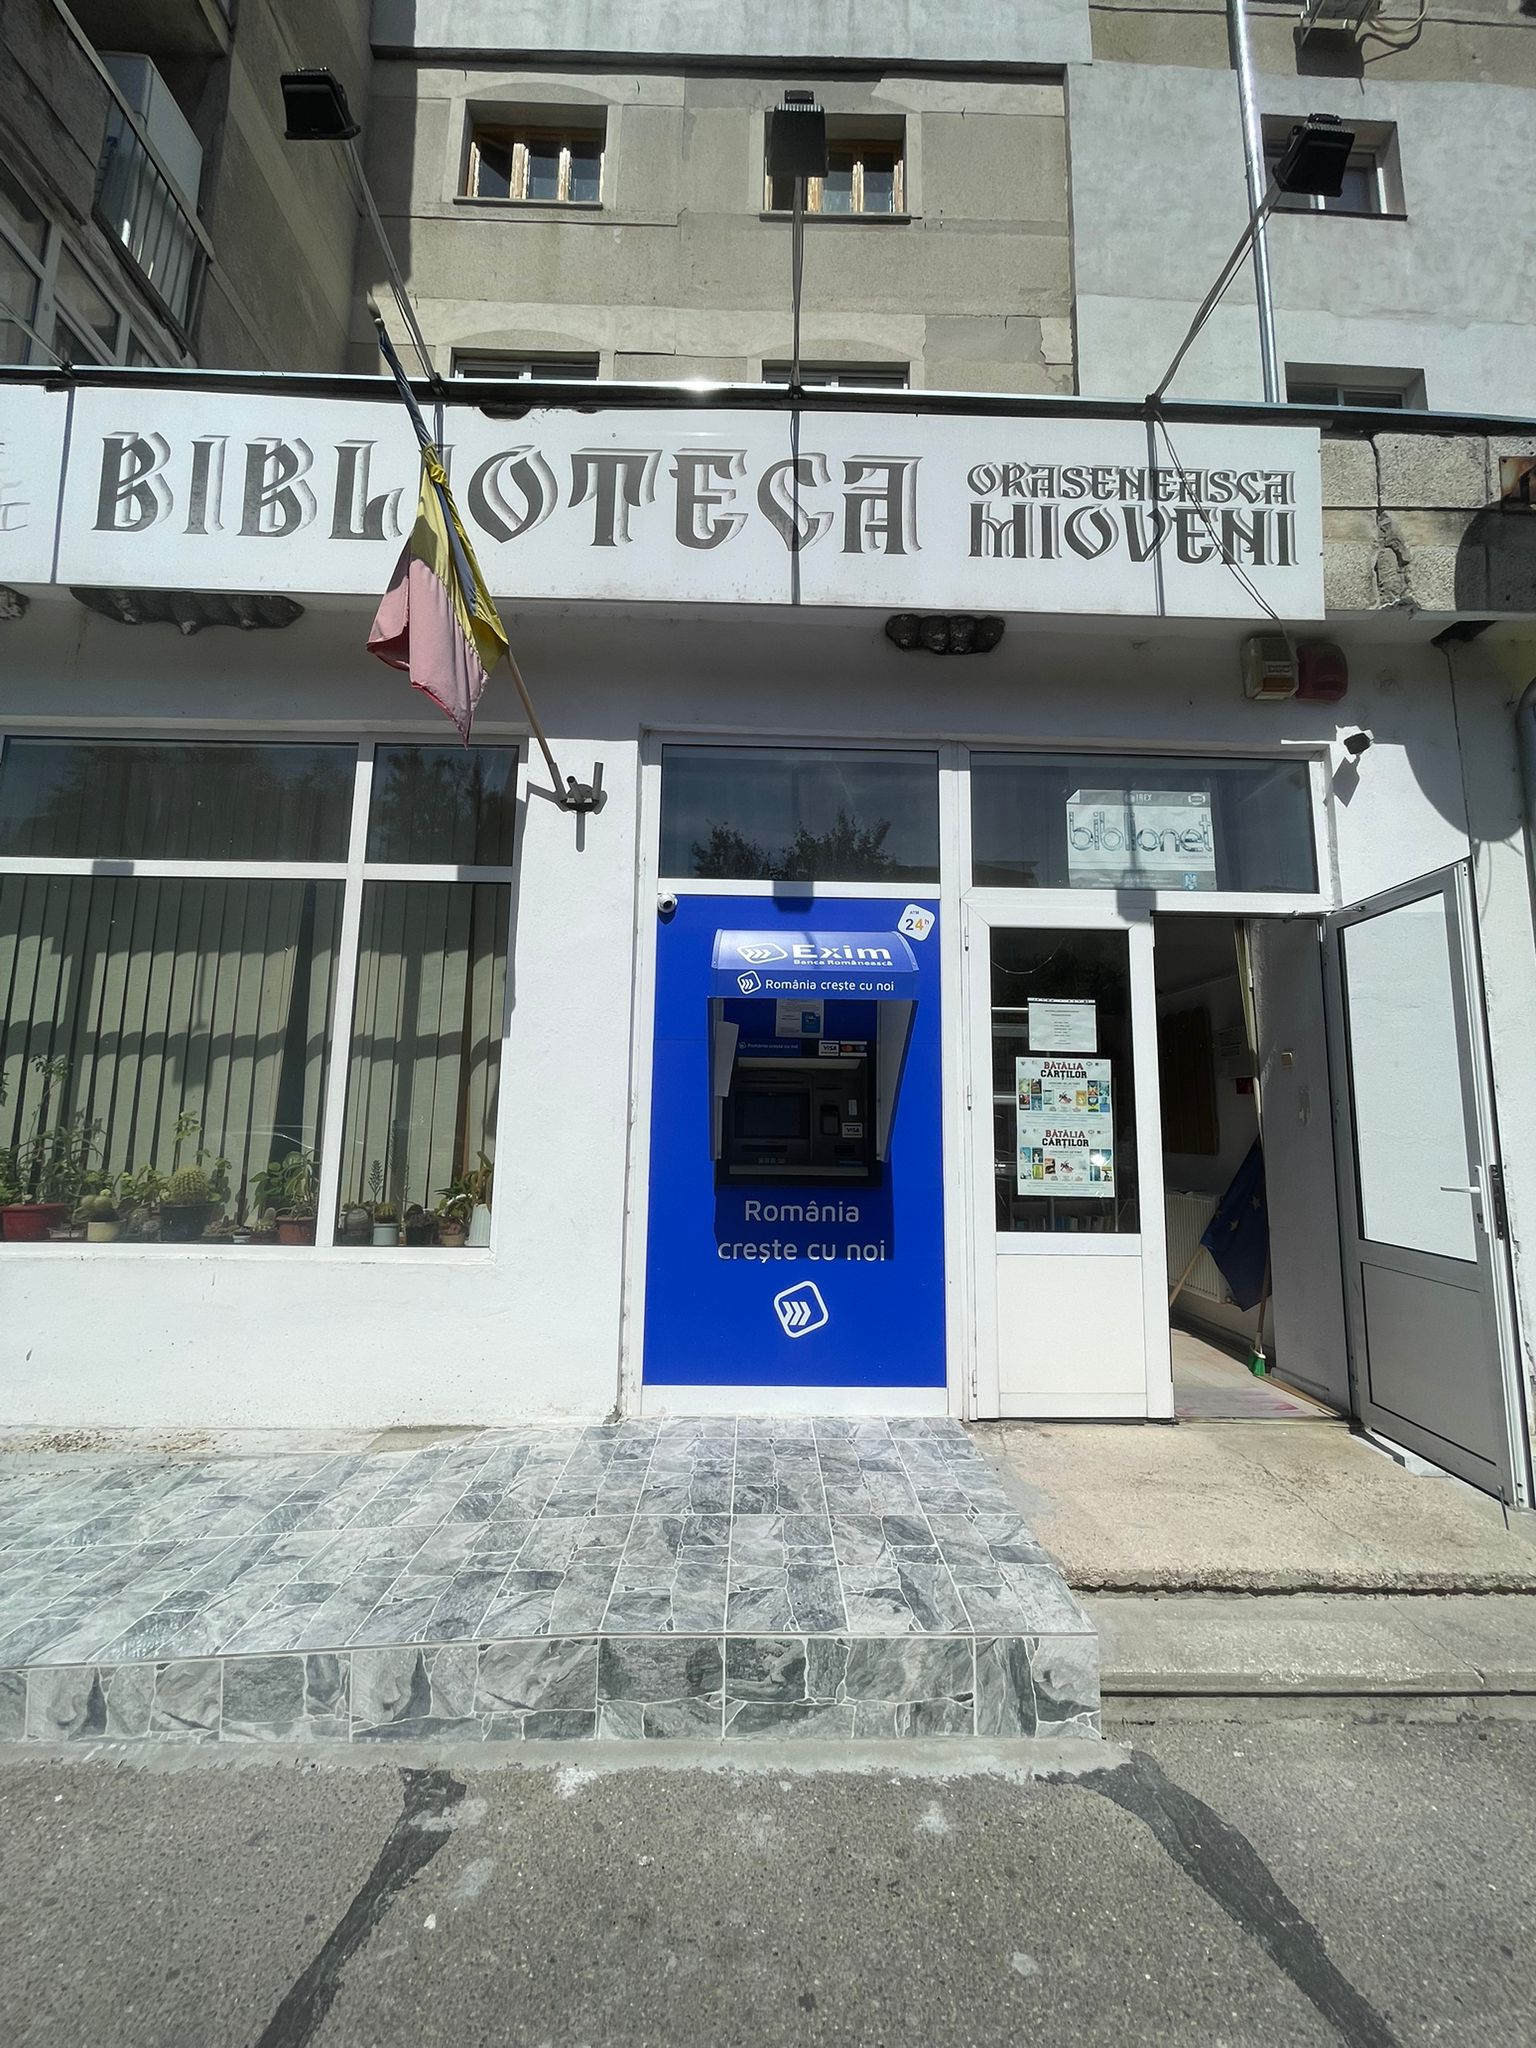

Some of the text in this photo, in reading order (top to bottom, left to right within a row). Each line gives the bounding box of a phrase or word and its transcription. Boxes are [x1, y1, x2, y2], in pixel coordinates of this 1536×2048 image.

[966, 462, 1297, 506] ORASENEASCA
[968, 501, 1299, 566] MIOVENI
[1069, 811, 1213, 852] biblionet
[792, 944, 892, 959] Exim
[793, 958, 894, 967] Banca Românească
[765, 979, 895, 992] România crește cu noi
[745, 1200, 860, 1222] România
[717, 1239, 886, 1264] crește cu noi
